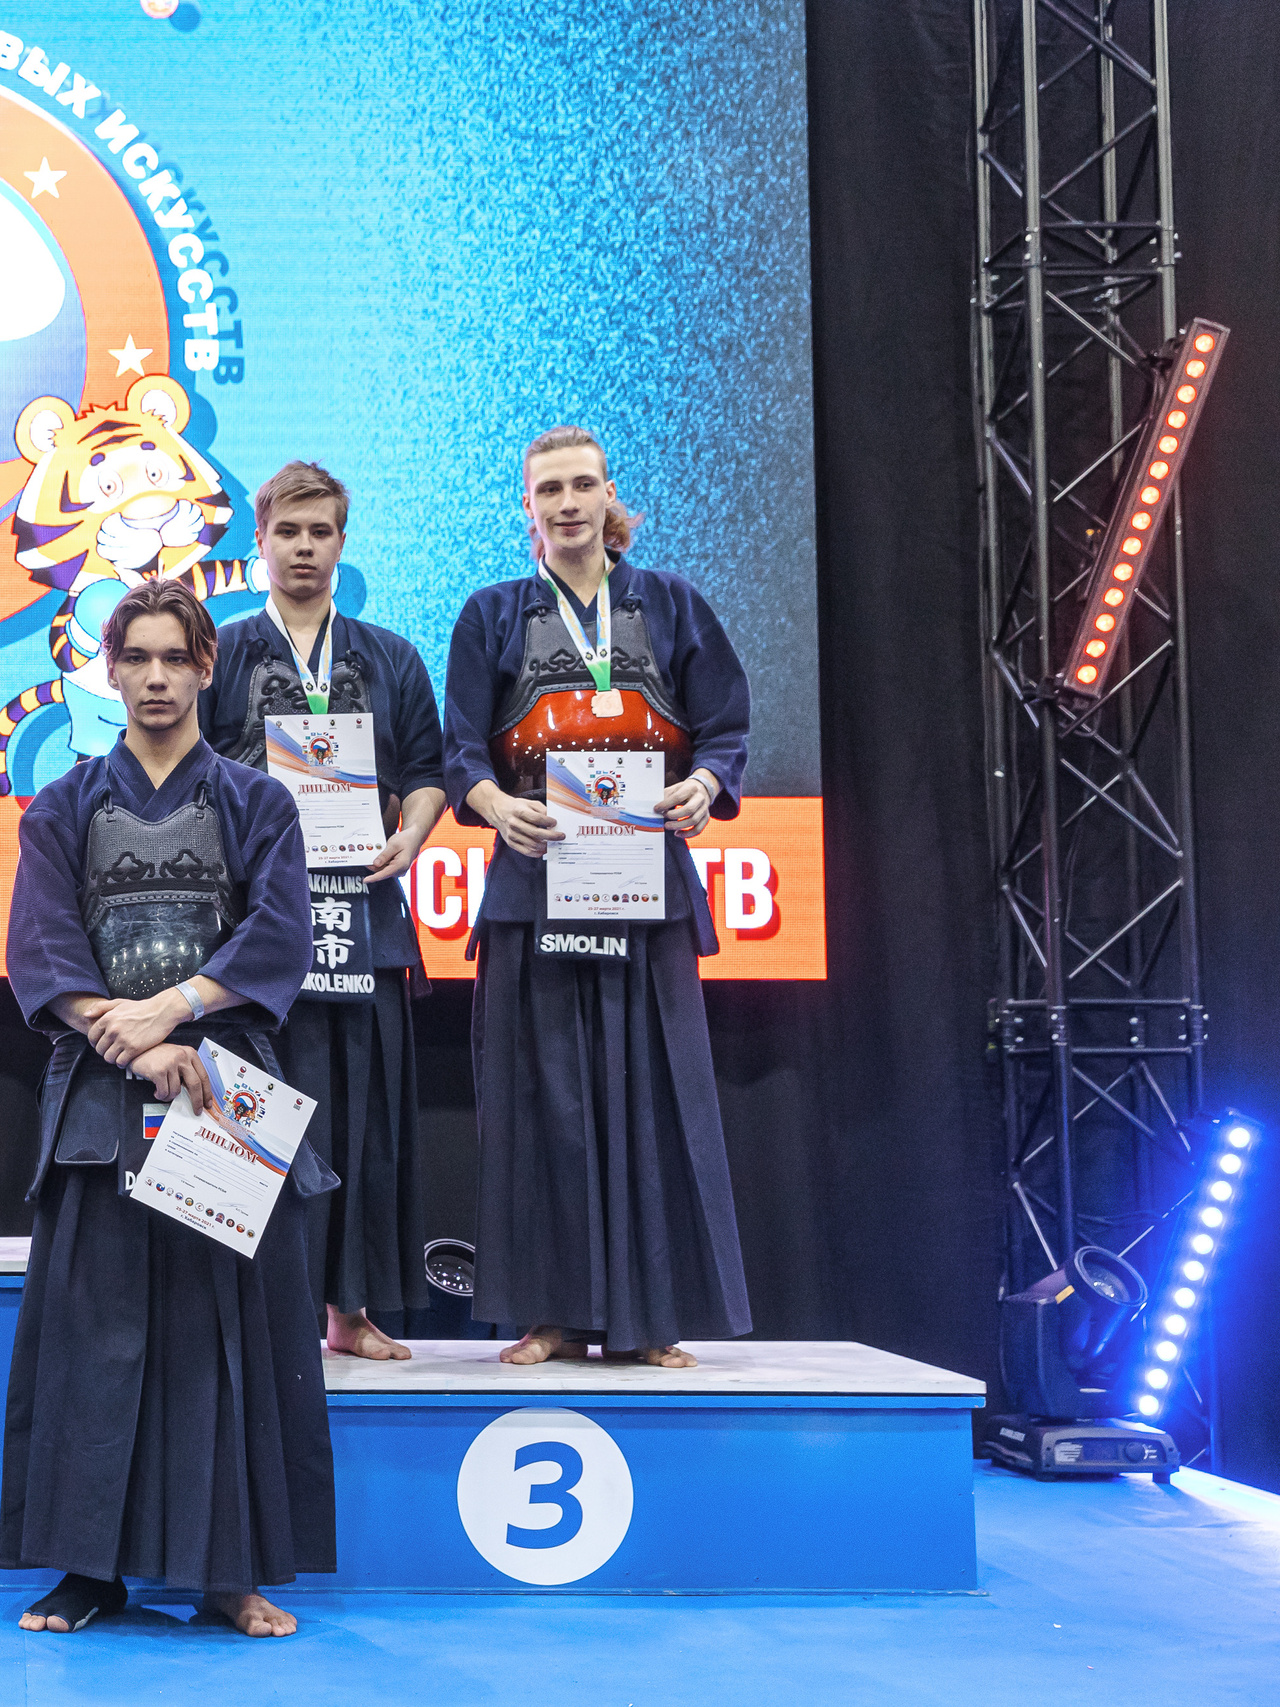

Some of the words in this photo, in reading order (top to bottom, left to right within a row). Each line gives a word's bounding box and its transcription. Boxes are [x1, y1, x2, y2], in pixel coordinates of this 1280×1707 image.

[94, 108, 220, 371] ИСКУССТВ
[297, 782, 353, 796] ДИПЛОМ
[575, 825, 637, 839] ДИПЛОМ
[539, 933, 627, 957] SMOLIN
[194, 1125, 259, 1166] ДИПЛОМ
[506, 1442, 582, 1549] 3
